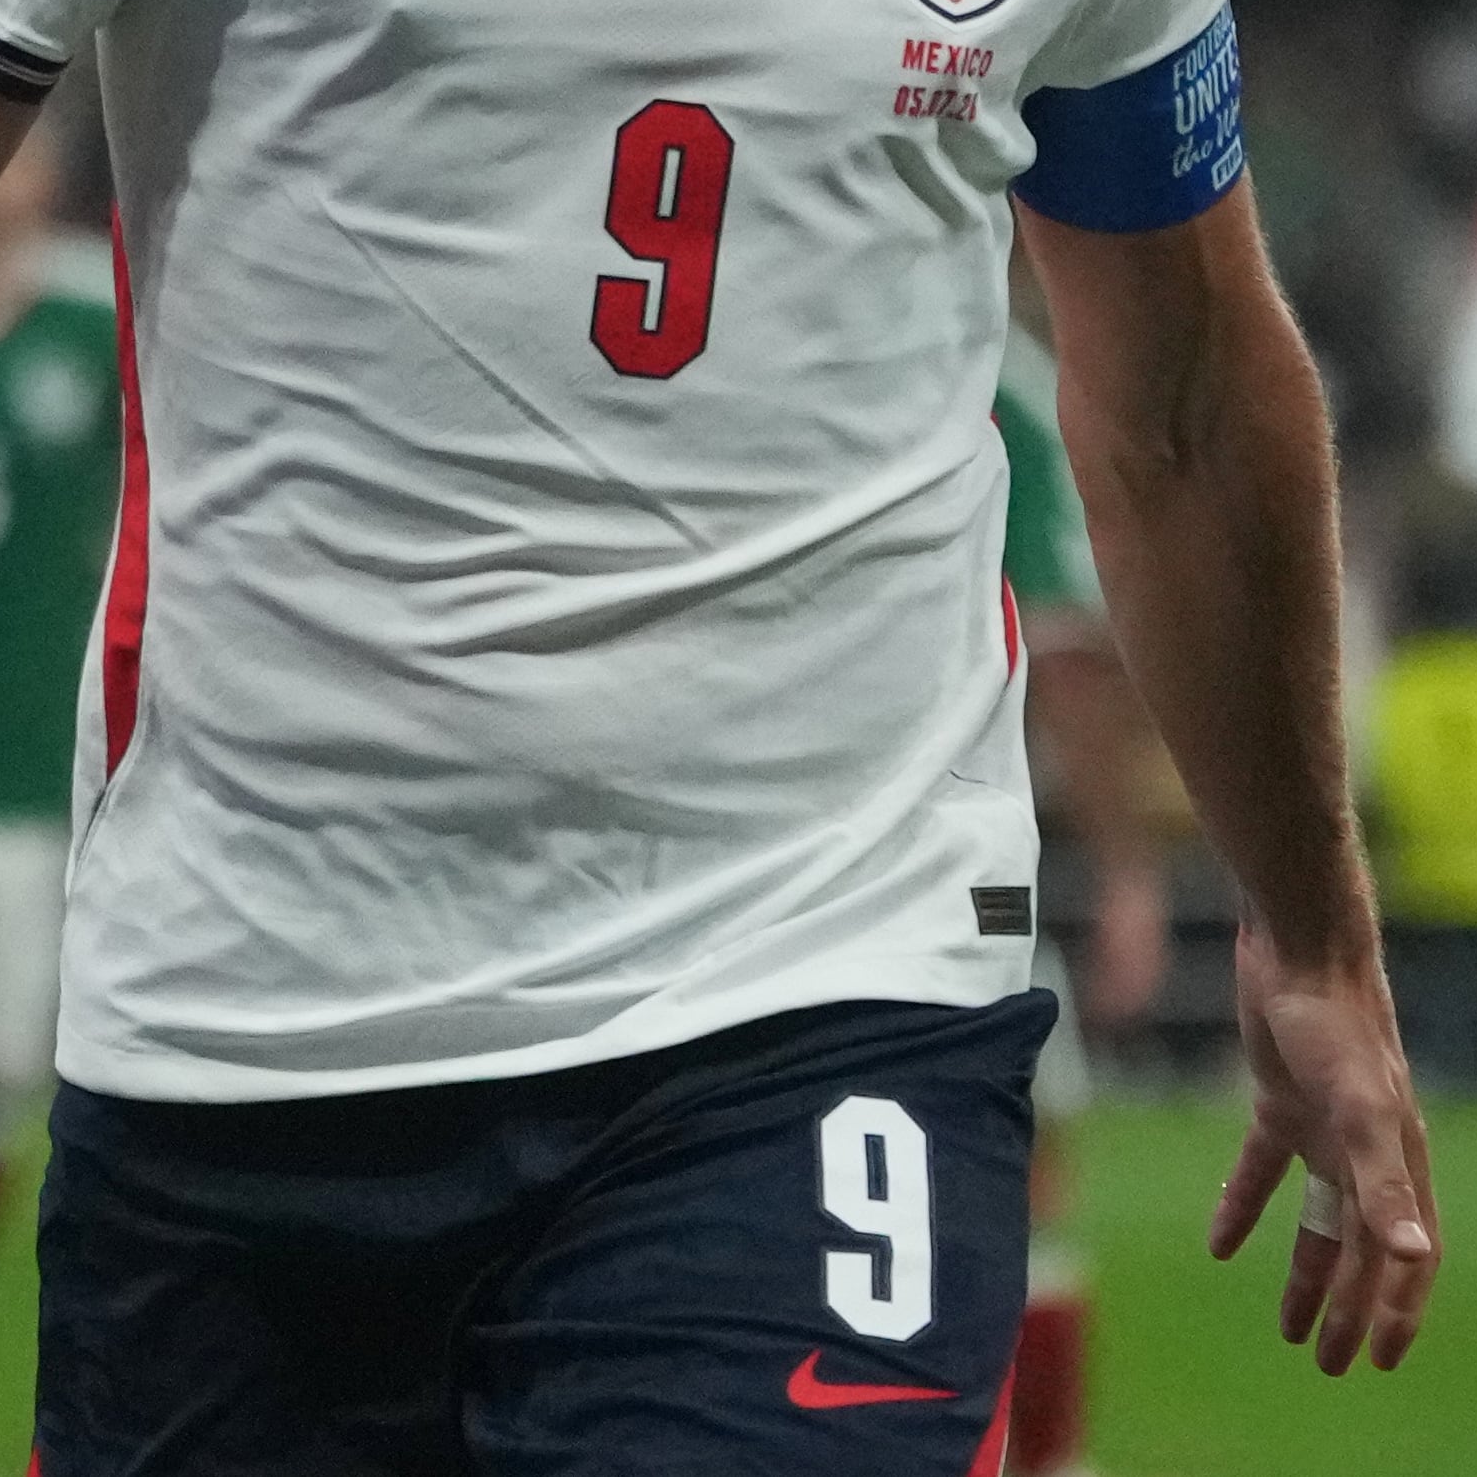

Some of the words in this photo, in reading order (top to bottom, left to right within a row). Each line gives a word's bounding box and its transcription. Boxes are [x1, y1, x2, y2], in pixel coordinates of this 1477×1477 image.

[902, 38, 994, 77] MEXICO
[590, 98, 735, 380] 9
[819, 1094, 934, 1343] 9
